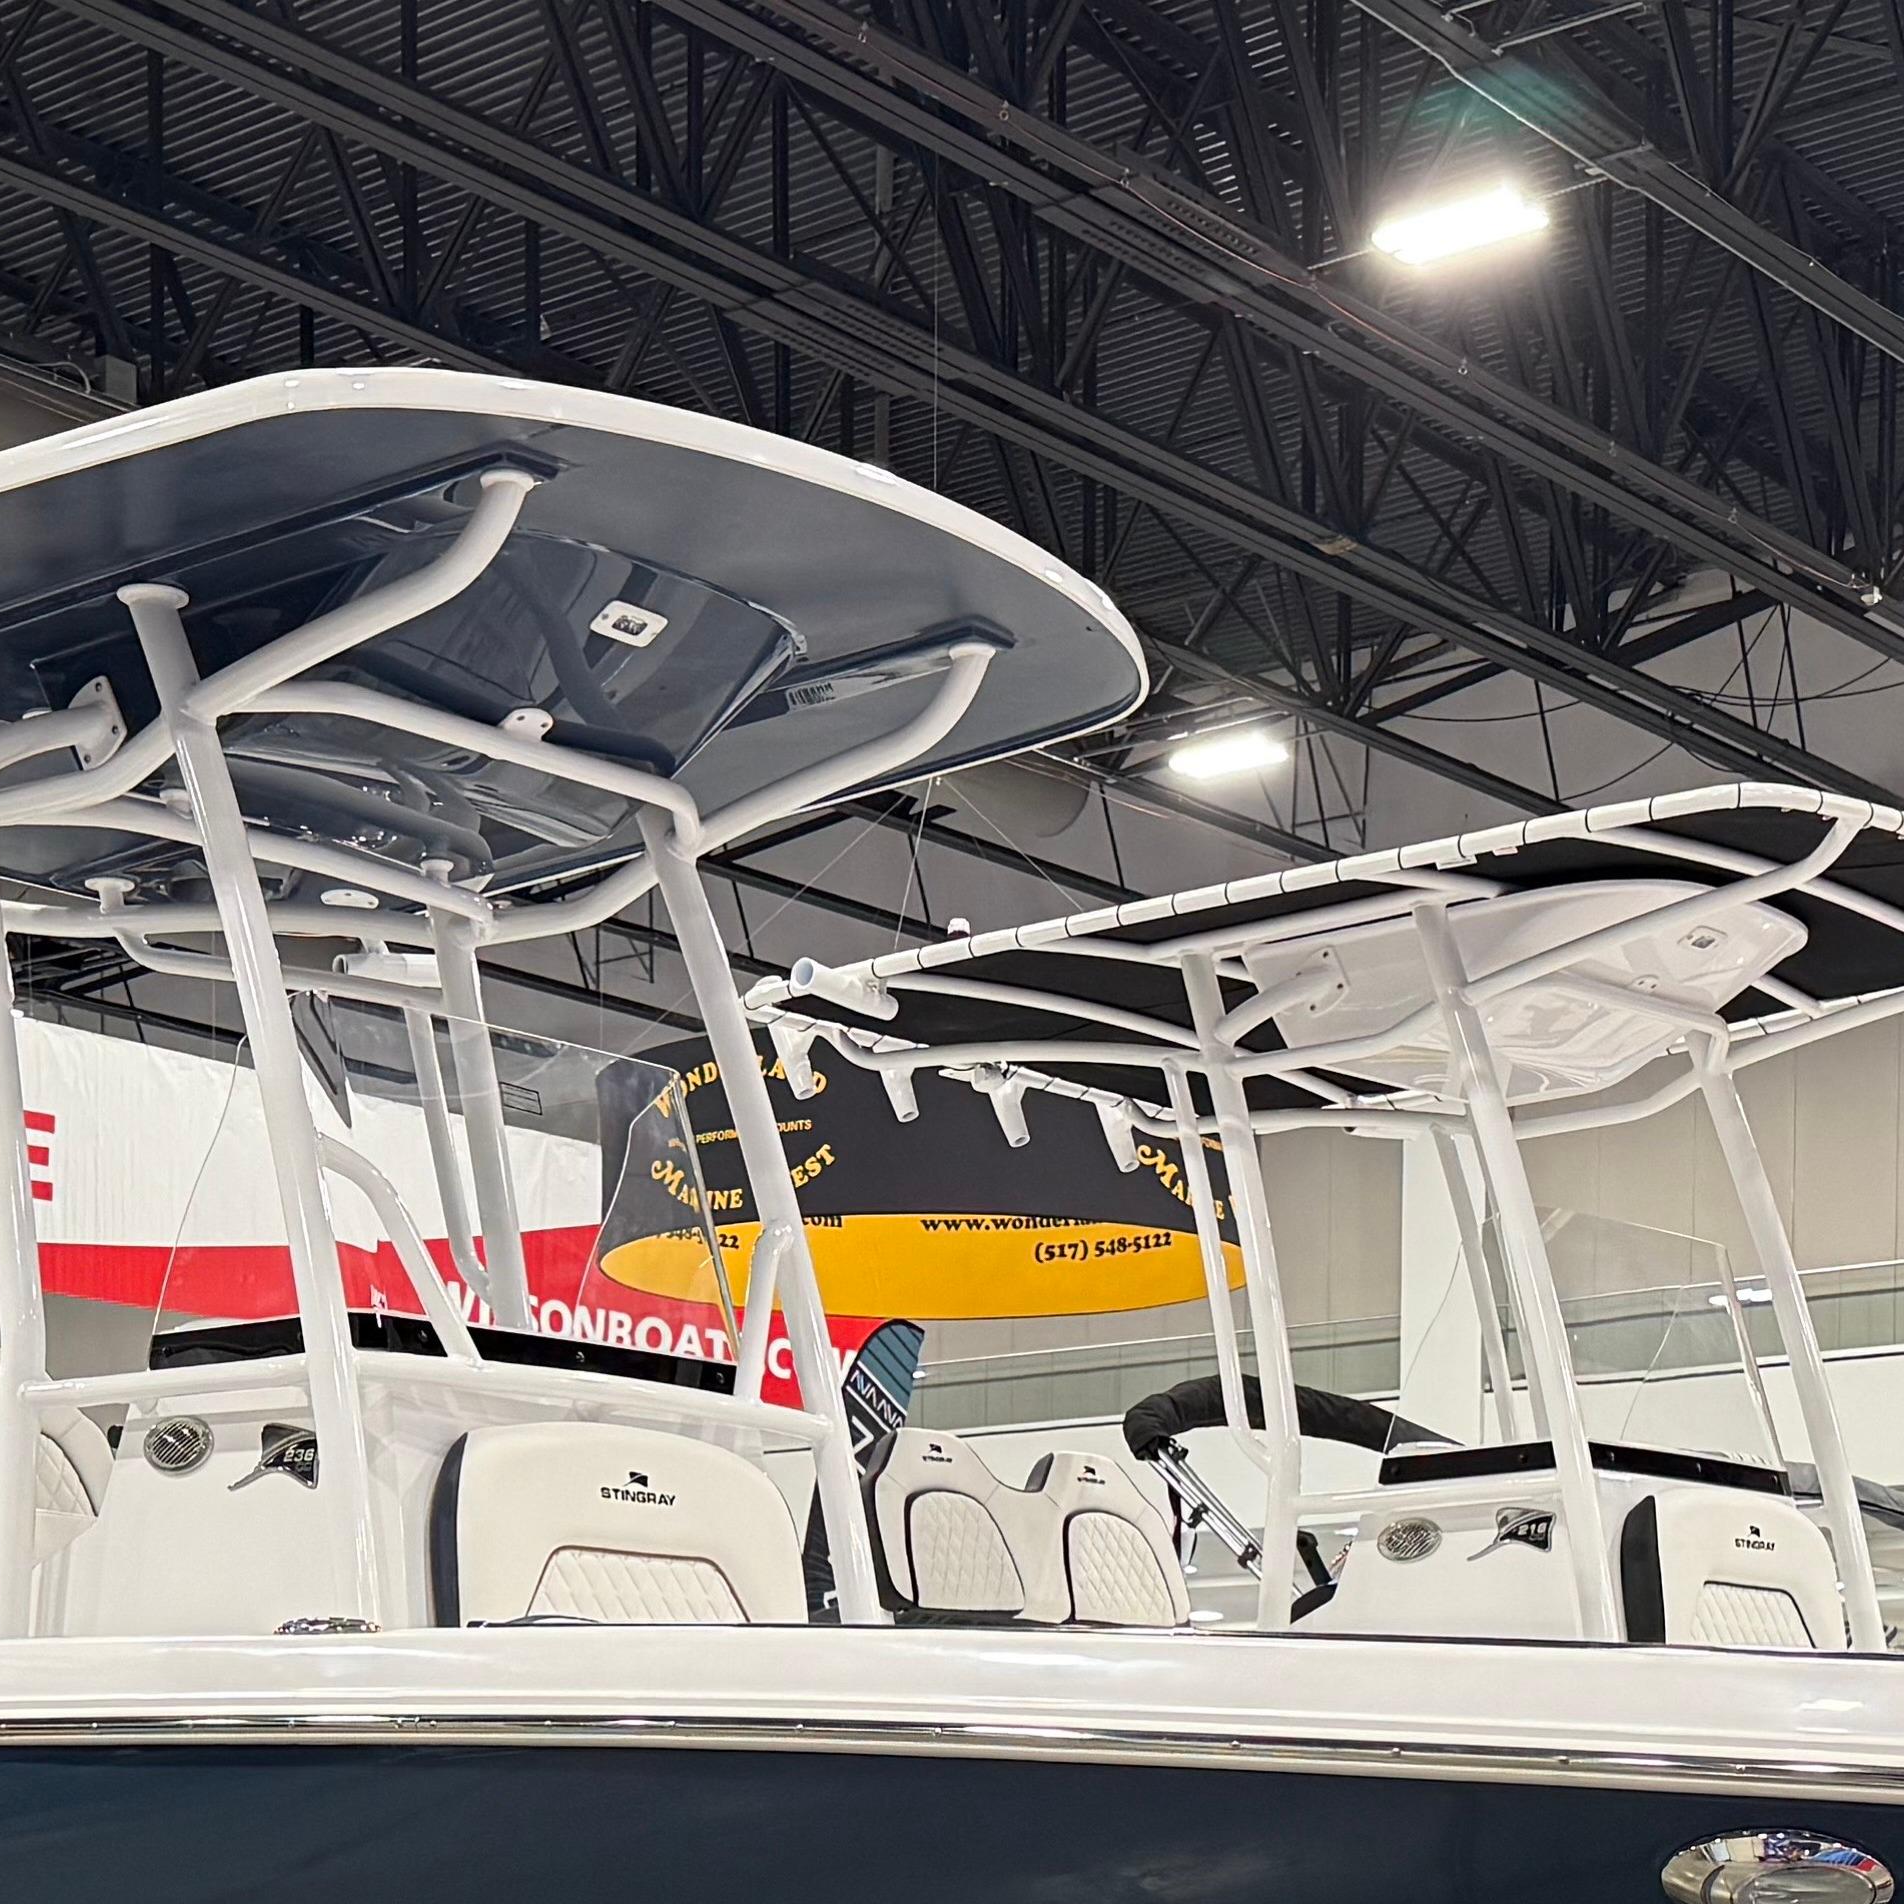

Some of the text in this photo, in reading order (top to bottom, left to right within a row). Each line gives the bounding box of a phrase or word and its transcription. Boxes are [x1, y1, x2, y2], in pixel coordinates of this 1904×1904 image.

[790, 1144, 836, 1188] EST
[1034, 1232, 1172, 1263] (517) 548-5122
[283, 1448, 315, 1463] 236
[600, 1487, 676, 1506] STINGRAY
